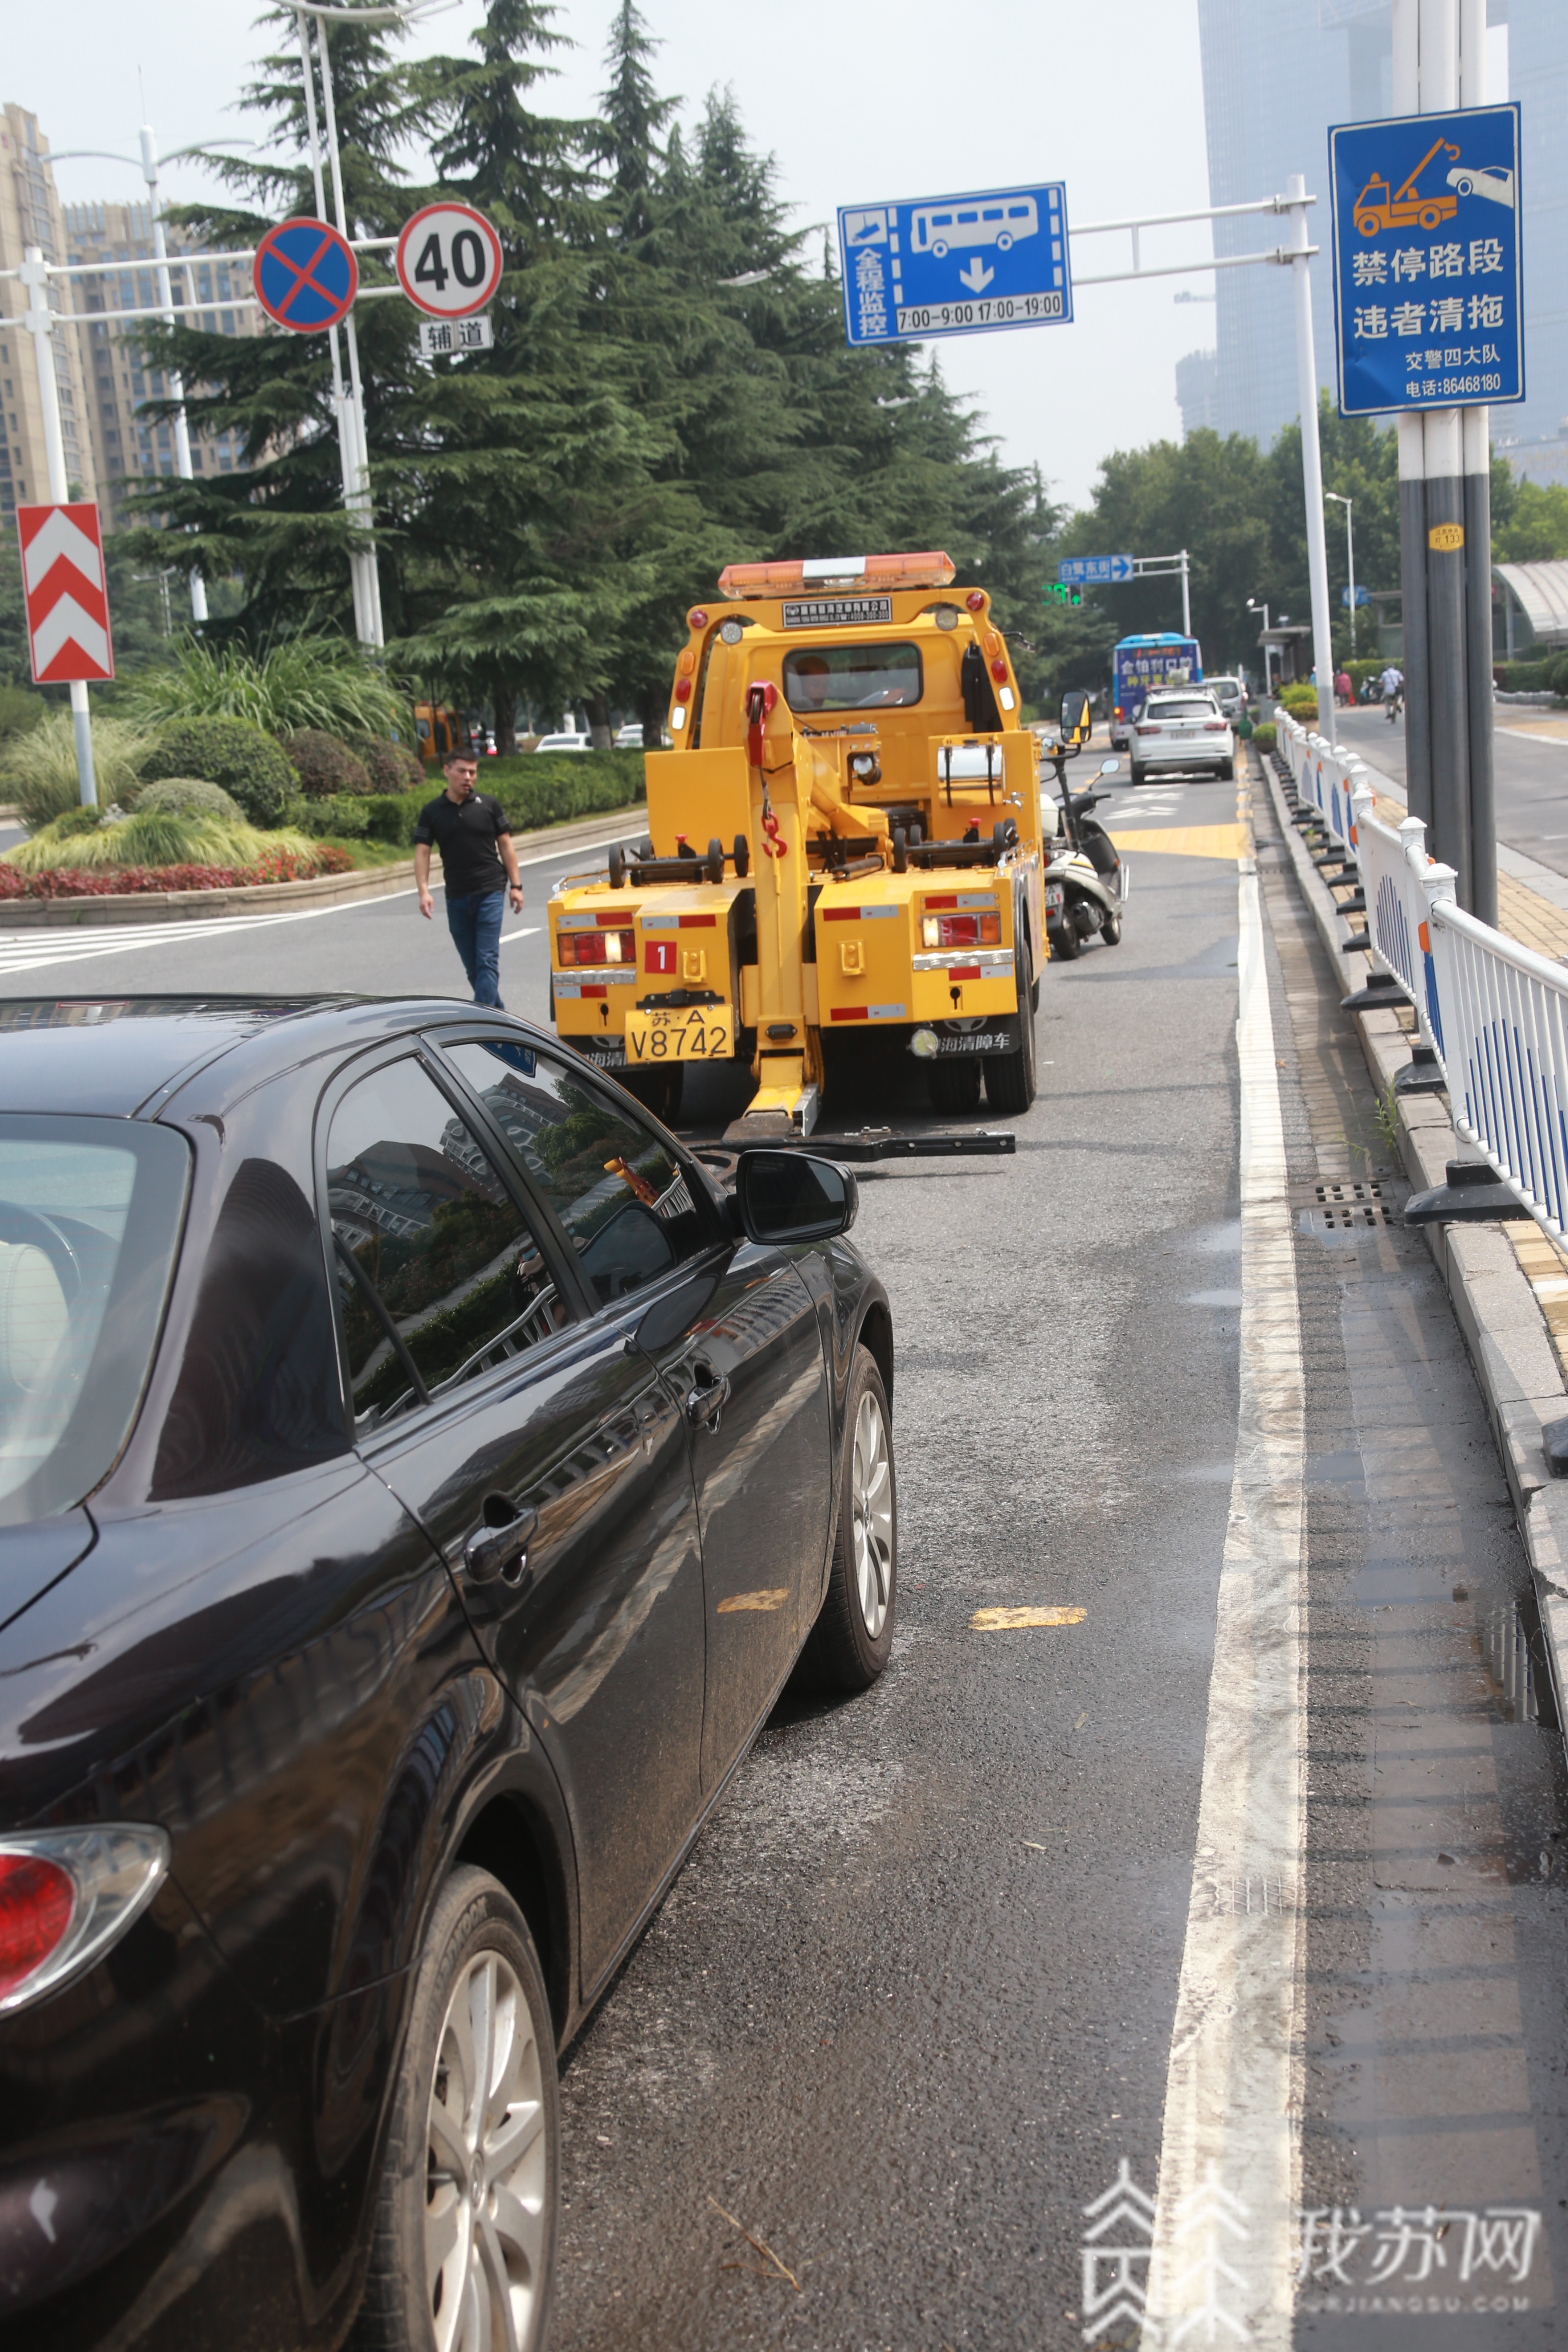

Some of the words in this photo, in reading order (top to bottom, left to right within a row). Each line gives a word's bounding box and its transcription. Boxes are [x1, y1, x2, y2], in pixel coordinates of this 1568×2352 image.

[415, 229, 485, 291] 40
[1353, 238, 1504, 287] 禁停路段
[855, 247, 888, 337] 全程监控
[899, 305, 972, 330] 7:00-9:00
[978, 296, 1060, 321] 17:00-19:00
[1354, 294, 1504, 339] 违者清拖
[427, 321, 483, 350] 辅道
[1406, 344, 1501, 371] 交警四大队
[1406, 373, 1501, 398] 电话:86468180
[1445, 534, 1459, 544] 133
[657, 945, 665, 969] 1
[631, 1026, 727, 1059] V8742
[938, 1033, 1010, 1052] 海清障车
